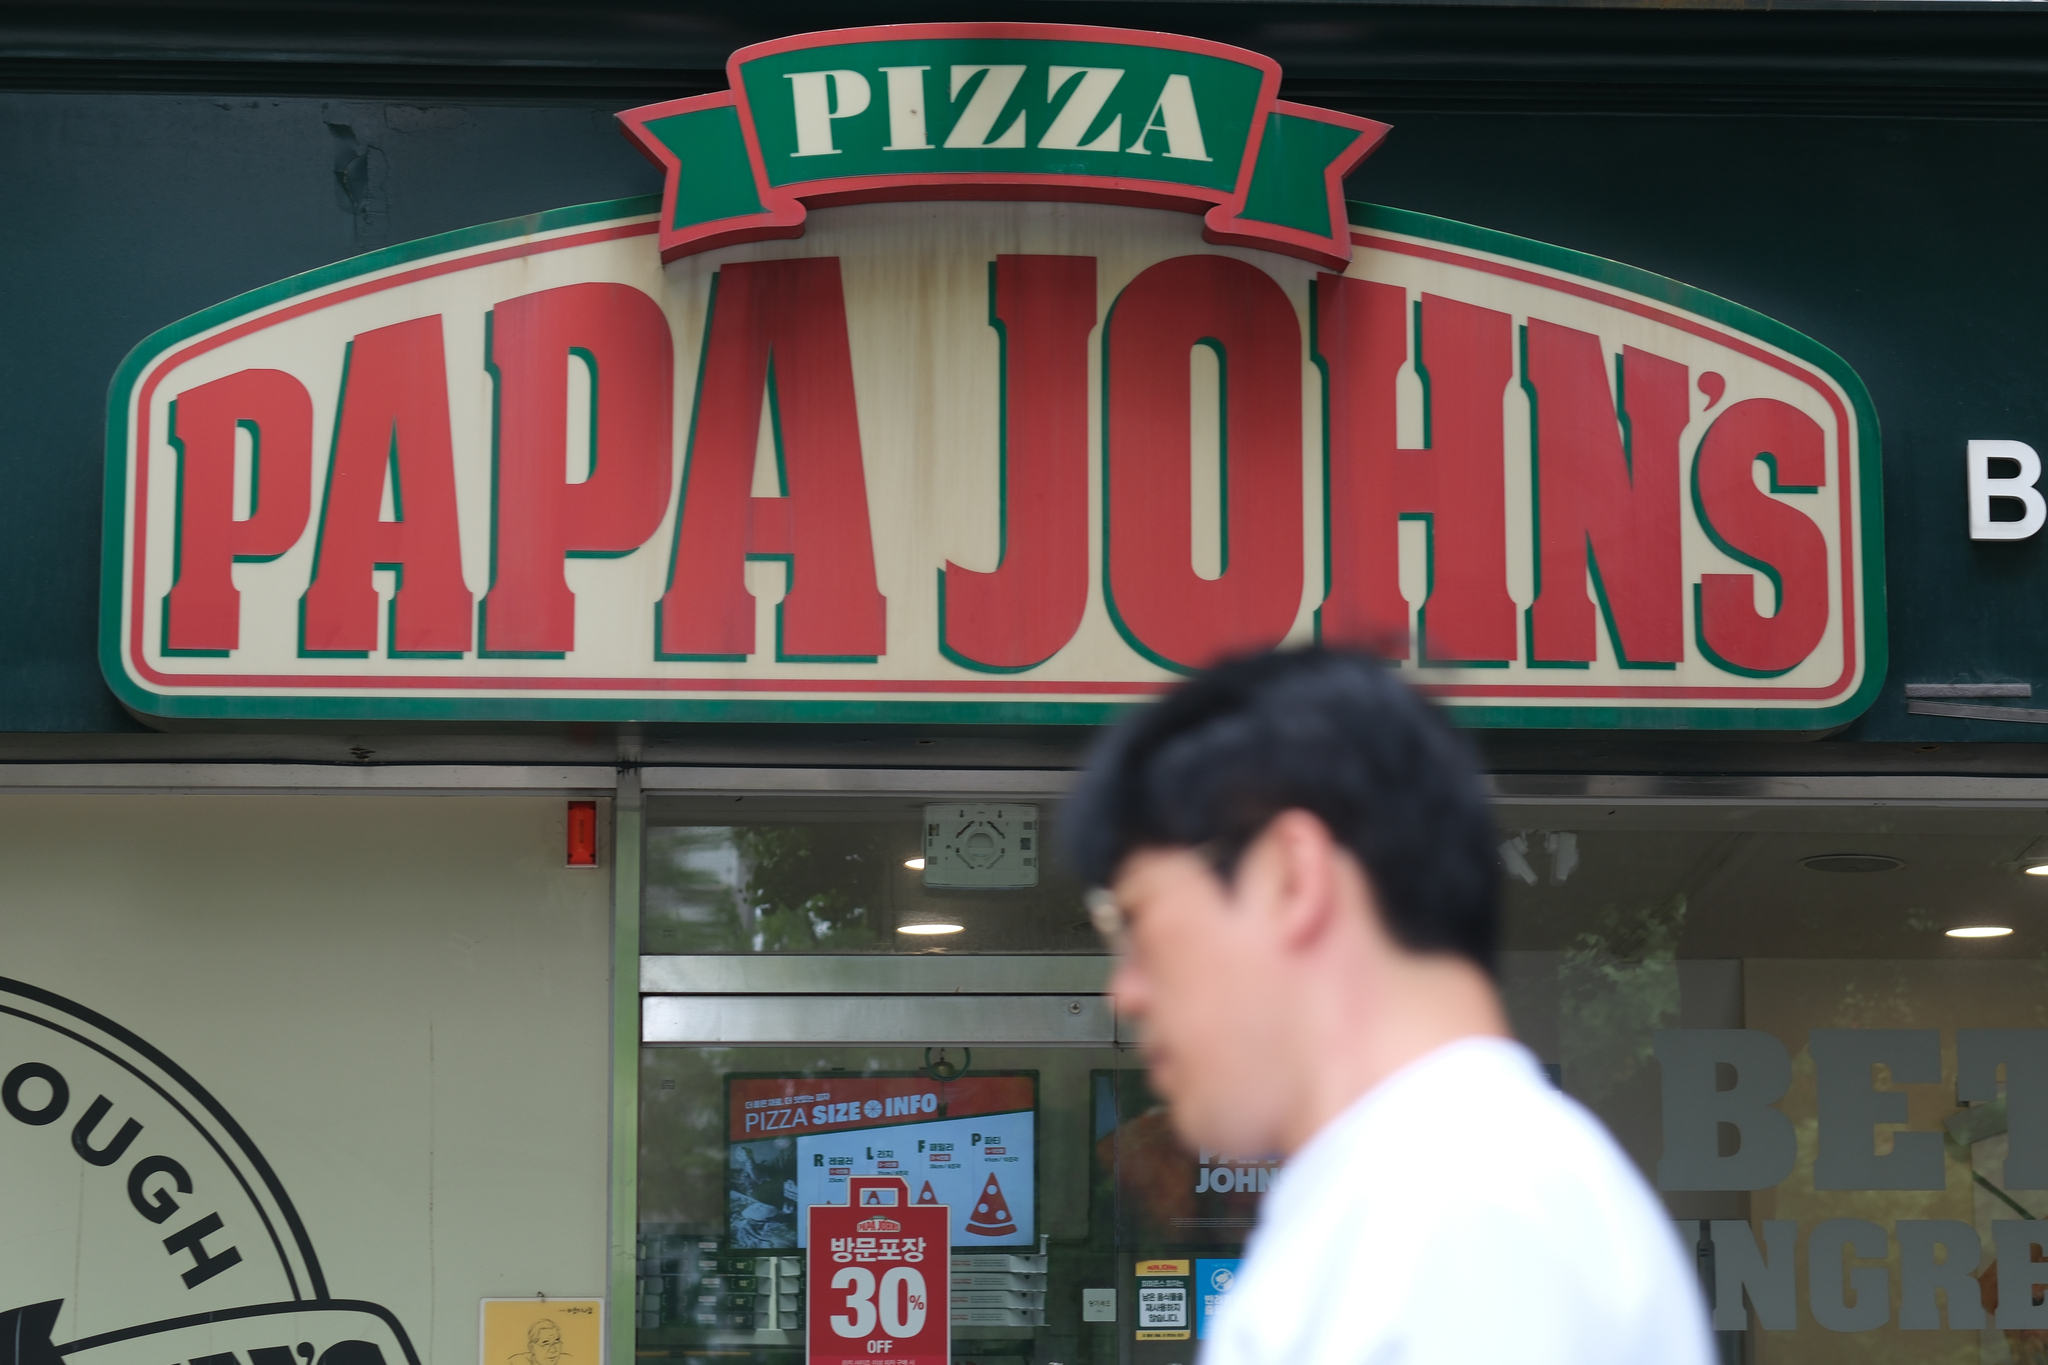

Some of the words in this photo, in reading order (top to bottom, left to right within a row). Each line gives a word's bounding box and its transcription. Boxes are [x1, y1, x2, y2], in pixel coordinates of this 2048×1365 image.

[783, 64, 1213, 162] PIZZA
[161, 257, 886, 663] PAPA
[937, 254, 1830, 678] JOHN'S
[1967, 440, 2048, 541] B
[745, 1108, 808, 1132] PIZZA
[812, 1101, 861, 1125] SIZE
[885, 1093, 937, 1117] INFO
[1653, 1029, 2048, 1191] BET
[918, 1140, 925, 1153] F
[971, 1133, 981, 1146] P
[814, 1153, 824, 1167] R
[866, 1147, 874, 1160] L
[877, 1150, 894, 1159] 라지
[1, 1062, 242, 1290] OUGH
[1195, 1167, 1287, 1193] JOHN
[831, 1237, 926, 1262] 방문포장
[1142, 1293, 1155, 1301] 남은
[1145, 1303, 1180, 1312] 재사용하지
[867, 1340, 893, 1353] OFF
